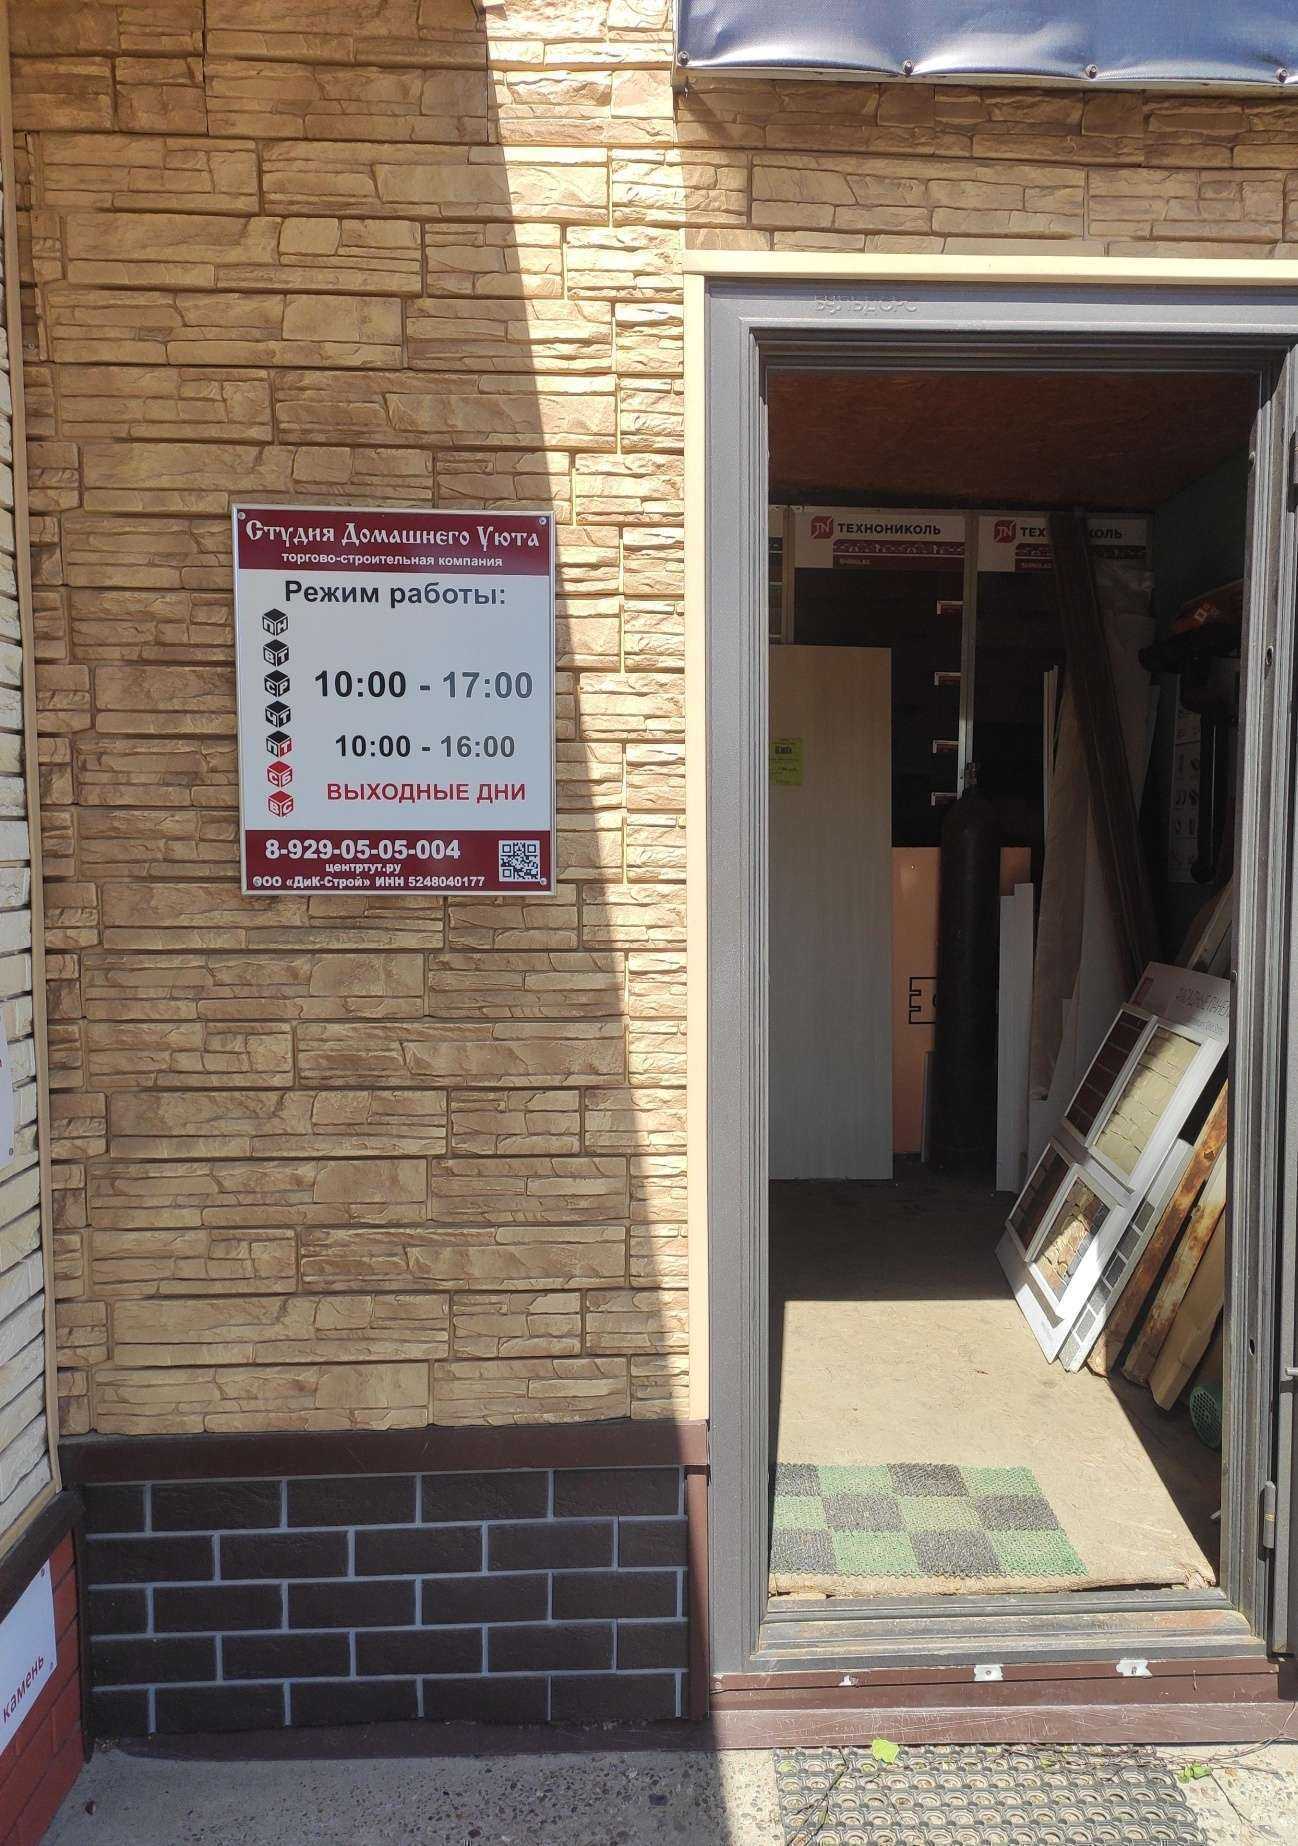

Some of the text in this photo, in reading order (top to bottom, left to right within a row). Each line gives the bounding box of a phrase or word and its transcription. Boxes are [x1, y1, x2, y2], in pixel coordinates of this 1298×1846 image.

[245, 519, 540, 551] Студия Домашнего Уюта
[837, 522, 941, 536] ТЕХНОНИКОЛЬ
[281, 552, 503, 568] торгово-строительная компания
[284, 580, 506, 609] Режим работы:
[314, 670, 407, 698] 10:00
[442, 671, 533, 699] 17:00
[335, 734, 411, 758] 10:00
[440, 735, 515, 758] 16:00
[327, 783, 526, 804] ВЫХОДНЫЕ ДНИ
[265, 839, 461, 860] 8-929-05-05-004
[325, 862, 401, 875] центртут.ру
[252, 876, 282, 888] ООО
[375, 877, 404, 888] ИНН
[408, 876, 485, 888] 5248040177
[3, 1655, 45, 1724] камень
